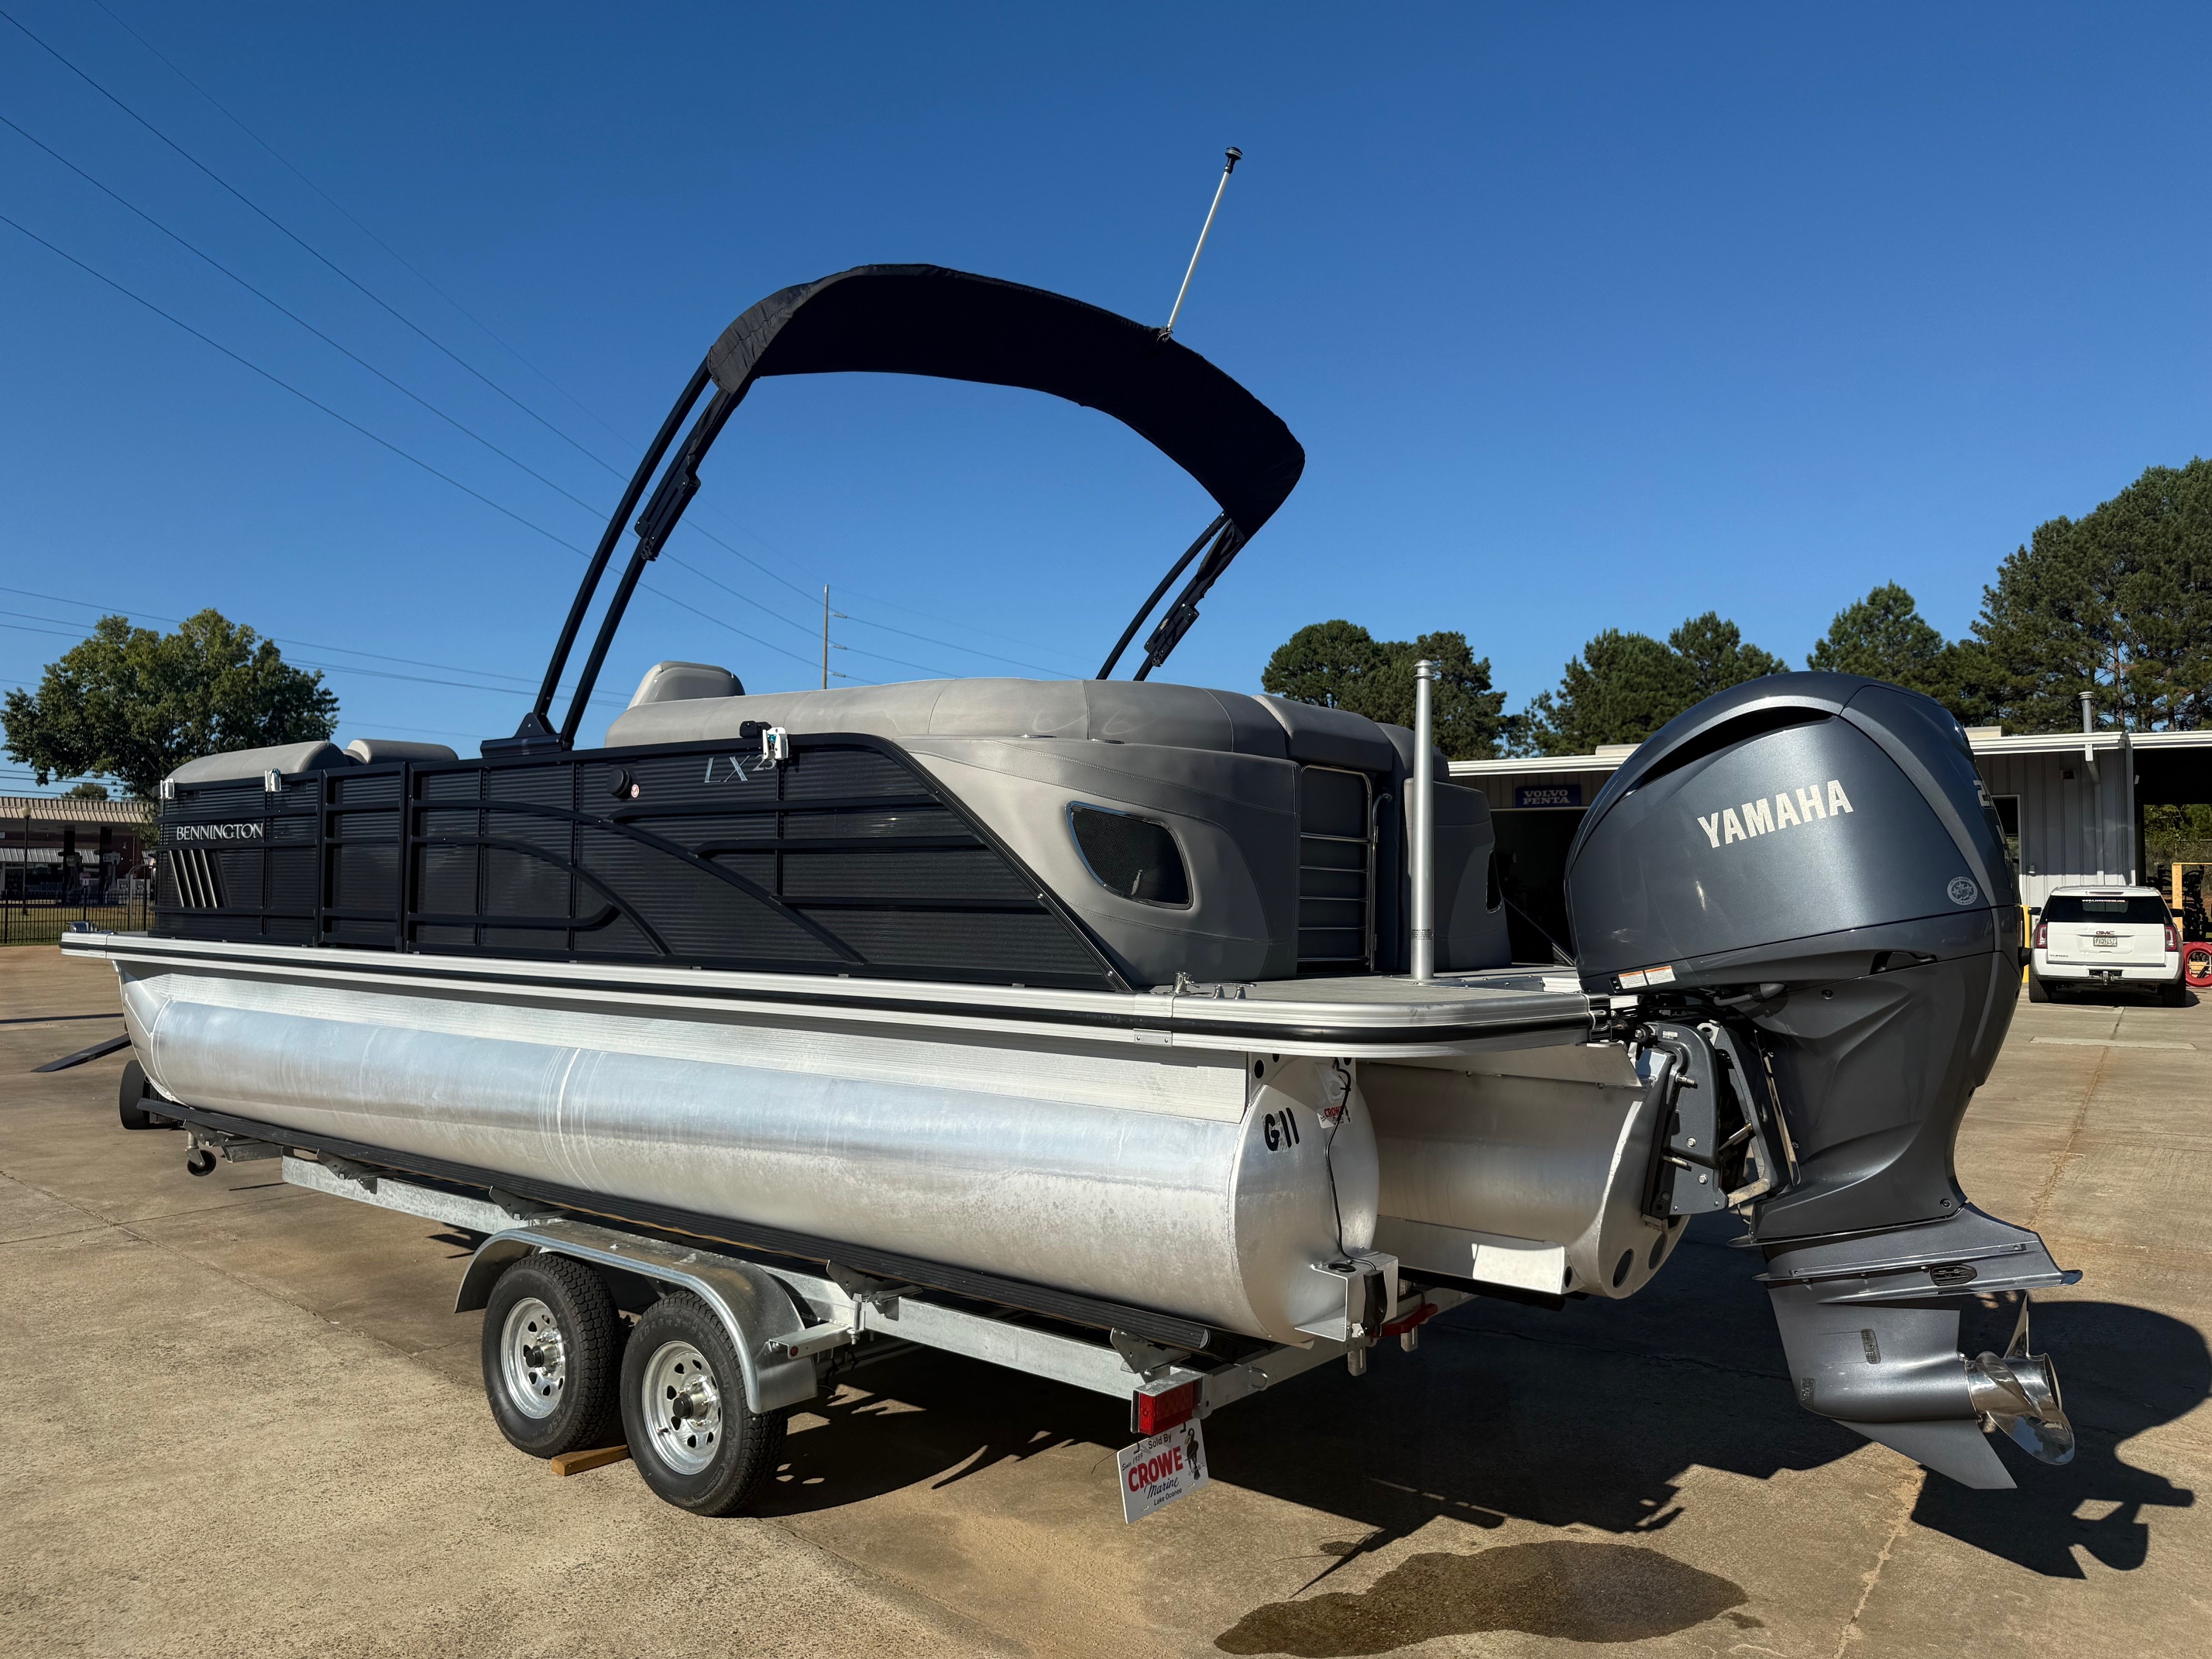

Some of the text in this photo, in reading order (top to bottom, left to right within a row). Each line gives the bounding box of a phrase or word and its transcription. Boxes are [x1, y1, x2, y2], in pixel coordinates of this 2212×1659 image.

[704, 755, 750, 783] LX
[1523, 789, 1568, 798] VOLVO
[1523, 796, 1571, 805] PENTA
[1697, 779, 1854, 849] YAMAHA
[177, 823, 263, 840] BENNINGTON
[1324, 1105, 1343, 1118] CROW
[1148, 1433, 1172, 1449] Sold By
[1128, 1445, 1183, 1492] CROWE
[1144, 1476, 1180, 1499] Marine
[1153, 1488, 1183, 1506] Lake Oconee
